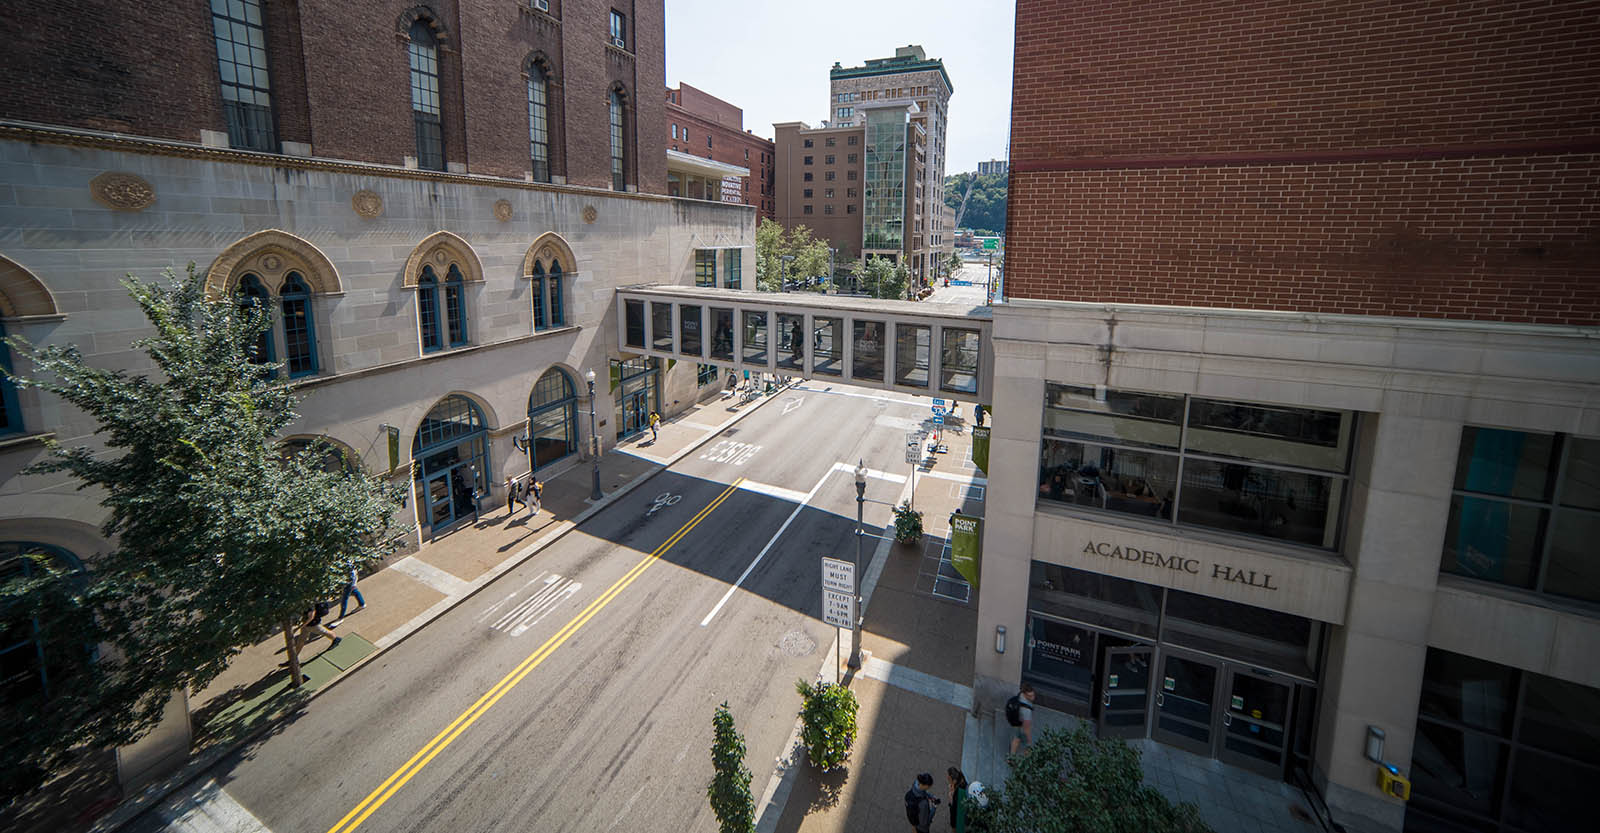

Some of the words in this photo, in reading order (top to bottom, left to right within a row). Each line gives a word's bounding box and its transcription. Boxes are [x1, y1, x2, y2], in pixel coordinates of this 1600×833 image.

[954, 518, 976, 528] POINT
[954, 524, 974, 532] PARK
[825, 562, 839, 570] RIGHT
[839, 565, 853, 573] LANE
[1083, 540, 1200, 574] ACADEMIC
[1211, 563, 1278, 590] HALL
[829, 571, 848, 581] MUST
[824, 578, 838, 586] TURN
[838, 582, 853, 590] RIGHT
[828, 592, 850, 603] EXCEPT
[1037, 639, 1060, 650] POINT
[1060, 645, 1081, 656] PARK
